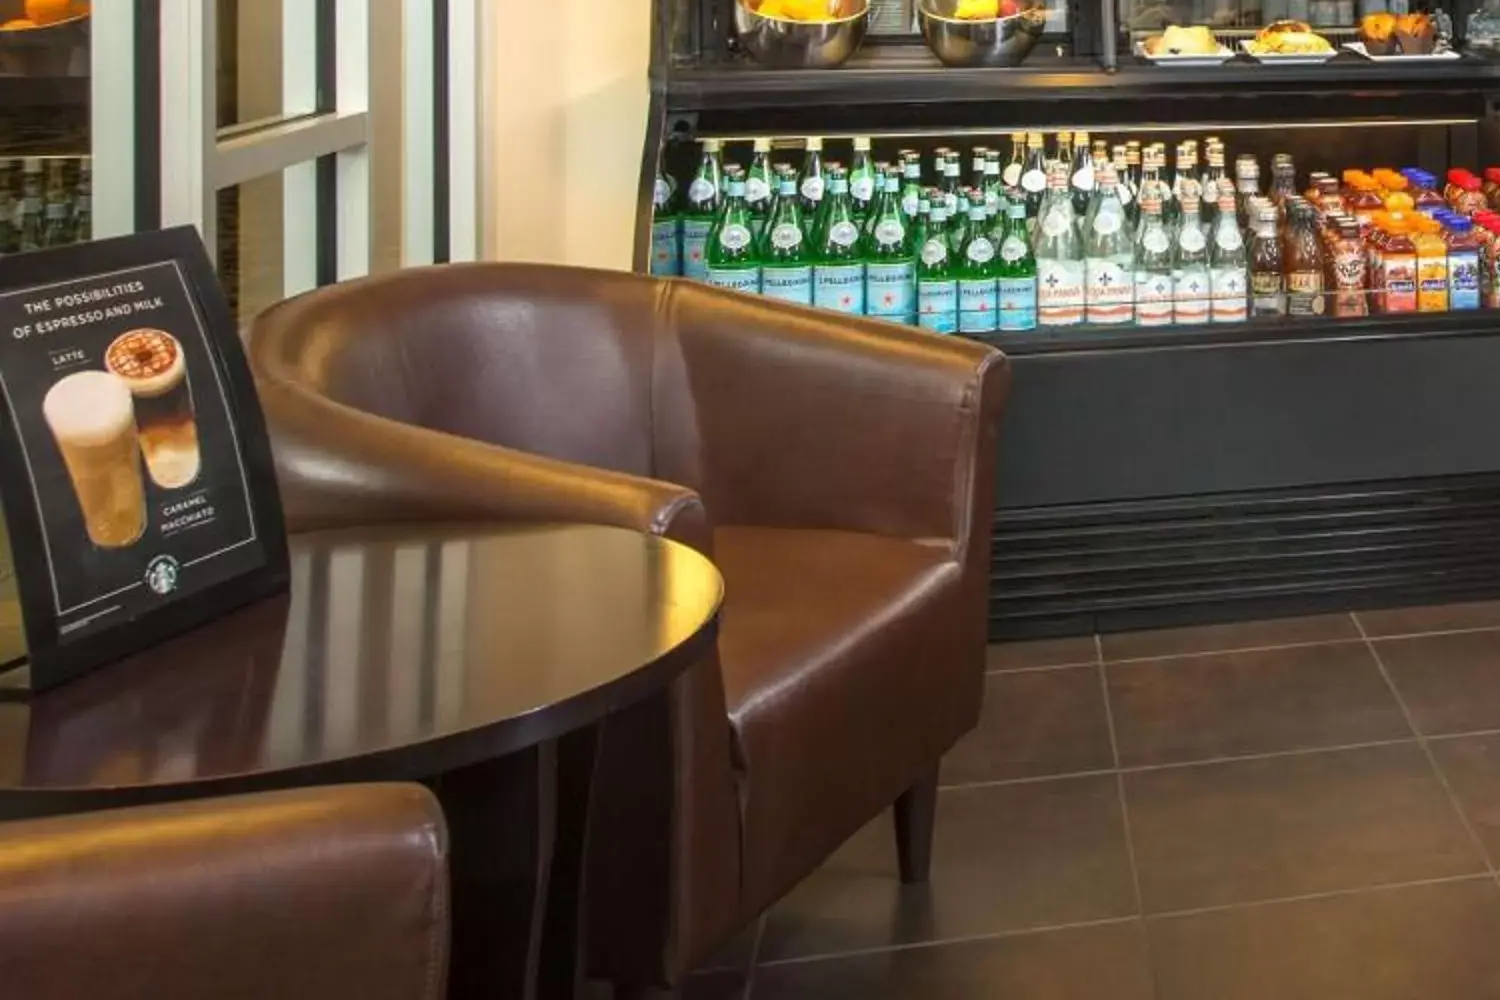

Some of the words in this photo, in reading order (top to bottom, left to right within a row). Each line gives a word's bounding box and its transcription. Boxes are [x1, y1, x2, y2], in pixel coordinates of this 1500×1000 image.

[24, 299, 51, 315] THE
[54, 281, 145, 307] POSSIBILITIES
[12, 325, 32, 339] OF
[35, 310, 104, 334] ESPRESSO
[105, 304, 133, 319] AND
[133, 297, 164, 313] MILK
[52, 350, 85, 365] LATTE
[160, 506, 215, 532] MACCHIATO
[162, 495, 207, 517] CARAMEL
